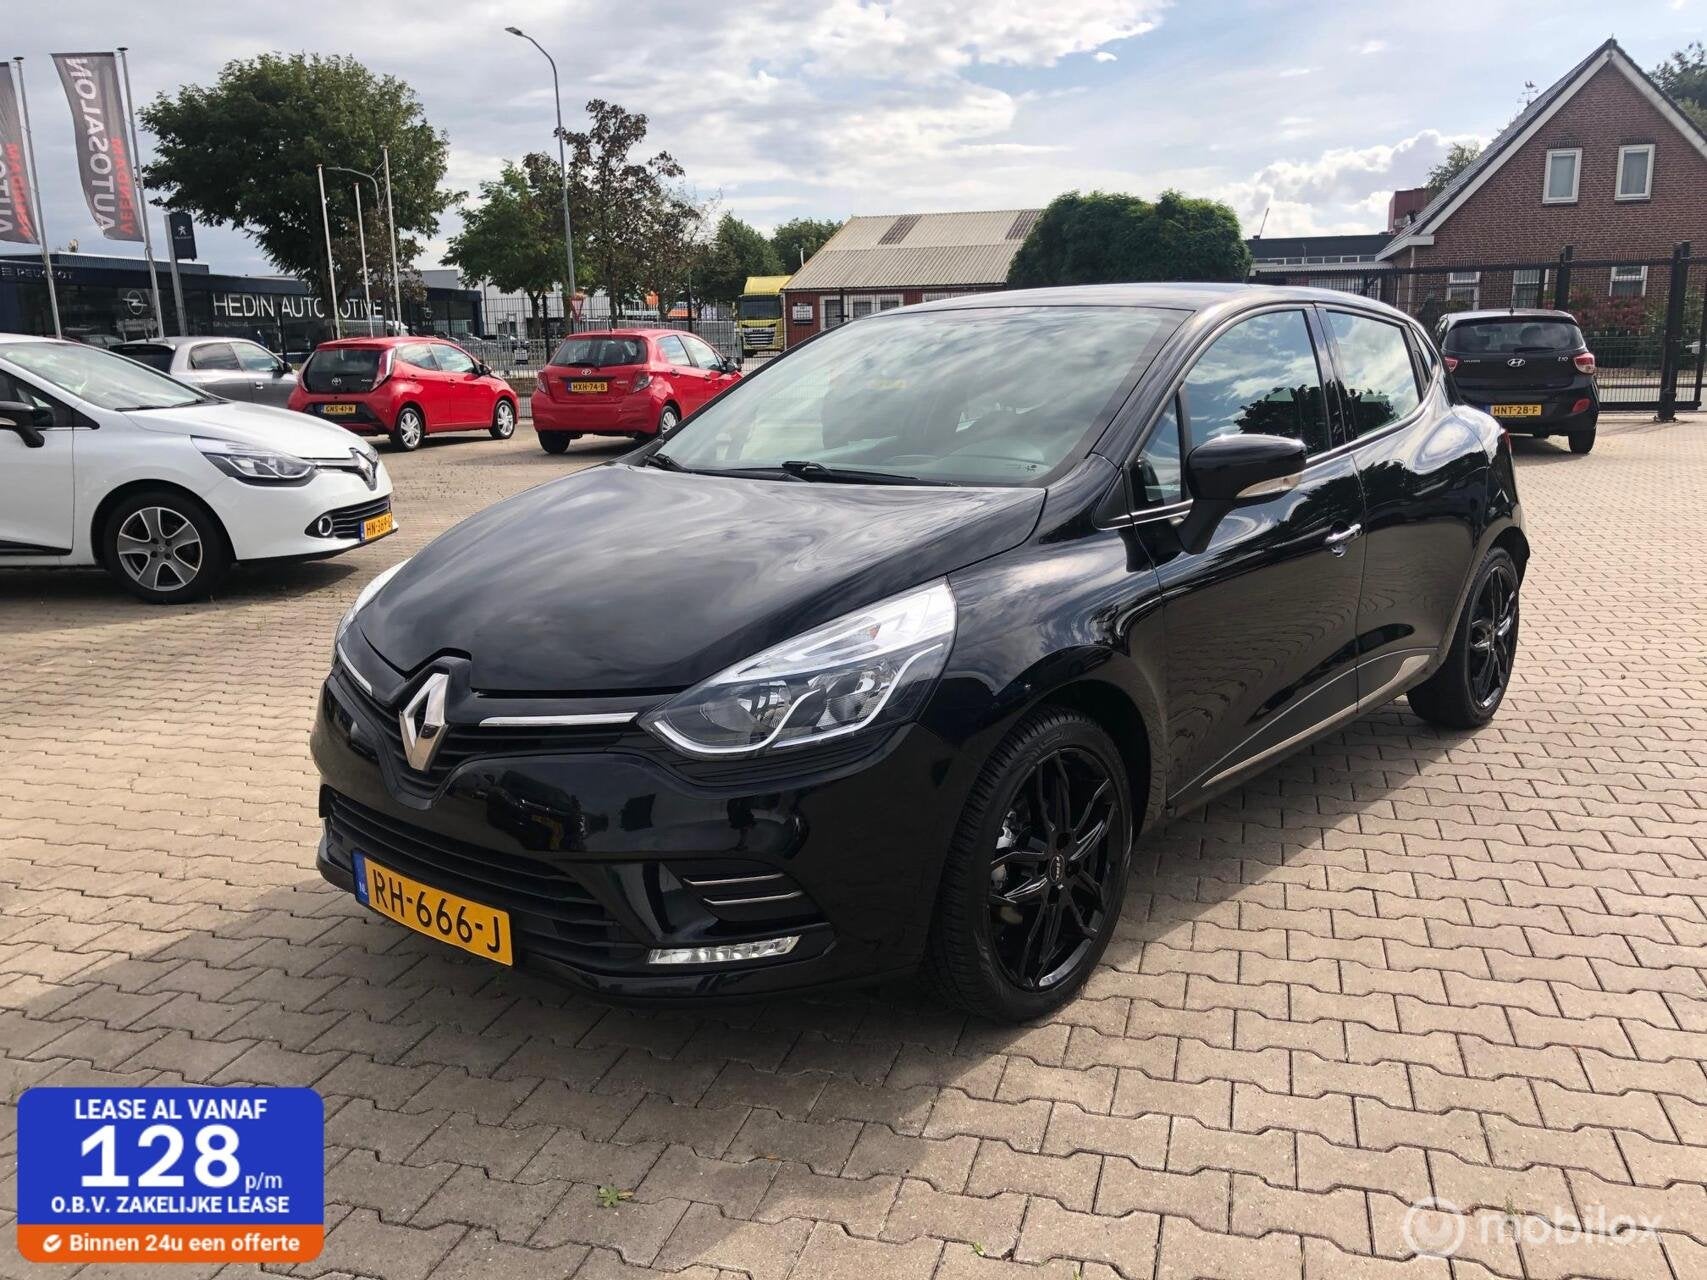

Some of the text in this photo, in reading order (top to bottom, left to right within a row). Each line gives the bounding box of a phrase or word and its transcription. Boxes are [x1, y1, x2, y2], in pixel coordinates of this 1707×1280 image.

[212, 293, 384, 319] HEDIN AUTOOTIVE
[1493, 406, 1539, 414] HNT-28-F
[372, 868, 501, 953] RH-666-J
